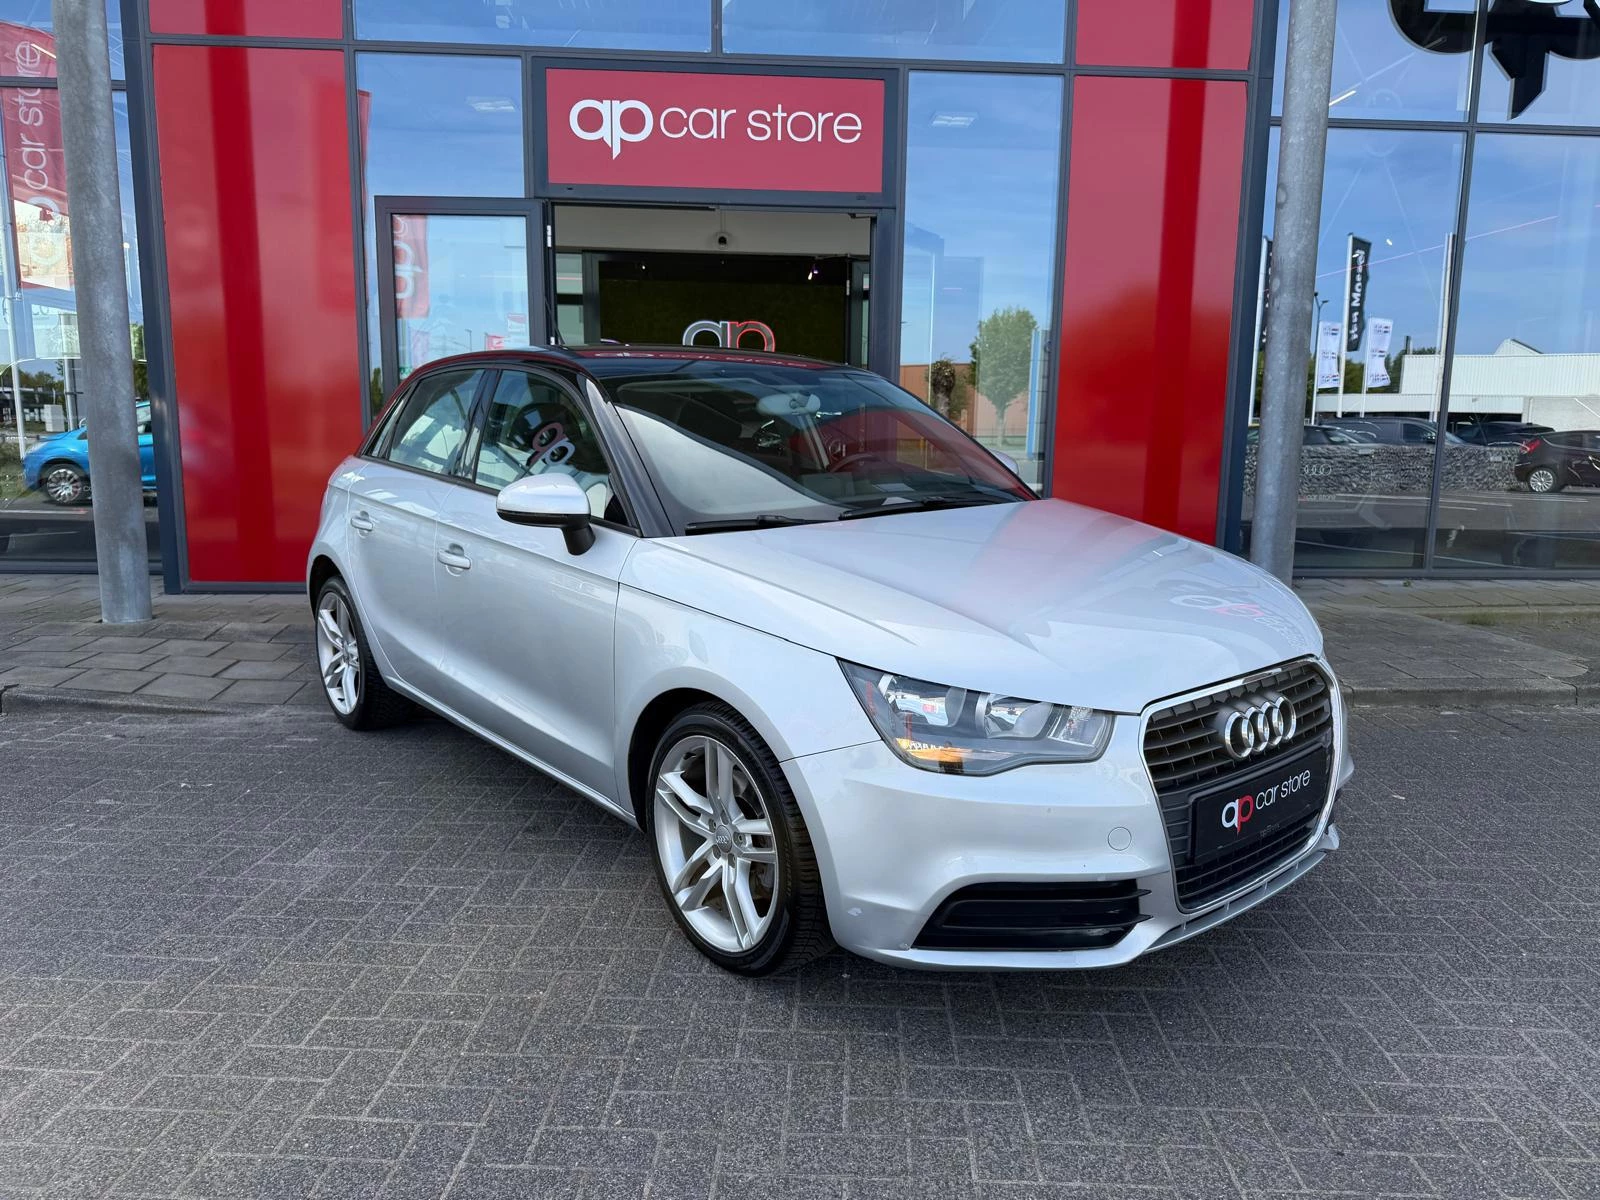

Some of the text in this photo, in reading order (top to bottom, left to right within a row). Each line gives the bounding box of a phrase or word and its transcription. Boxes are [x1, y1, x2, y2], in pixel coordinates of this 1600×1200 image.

[569, 99, 862, 160] ap car store
[19, 134, 49, 190] car
[1221, 795, 1254, 835] ap
[1255, 785, 1279, 810] car
[1280, 769, 1311, 798] store
